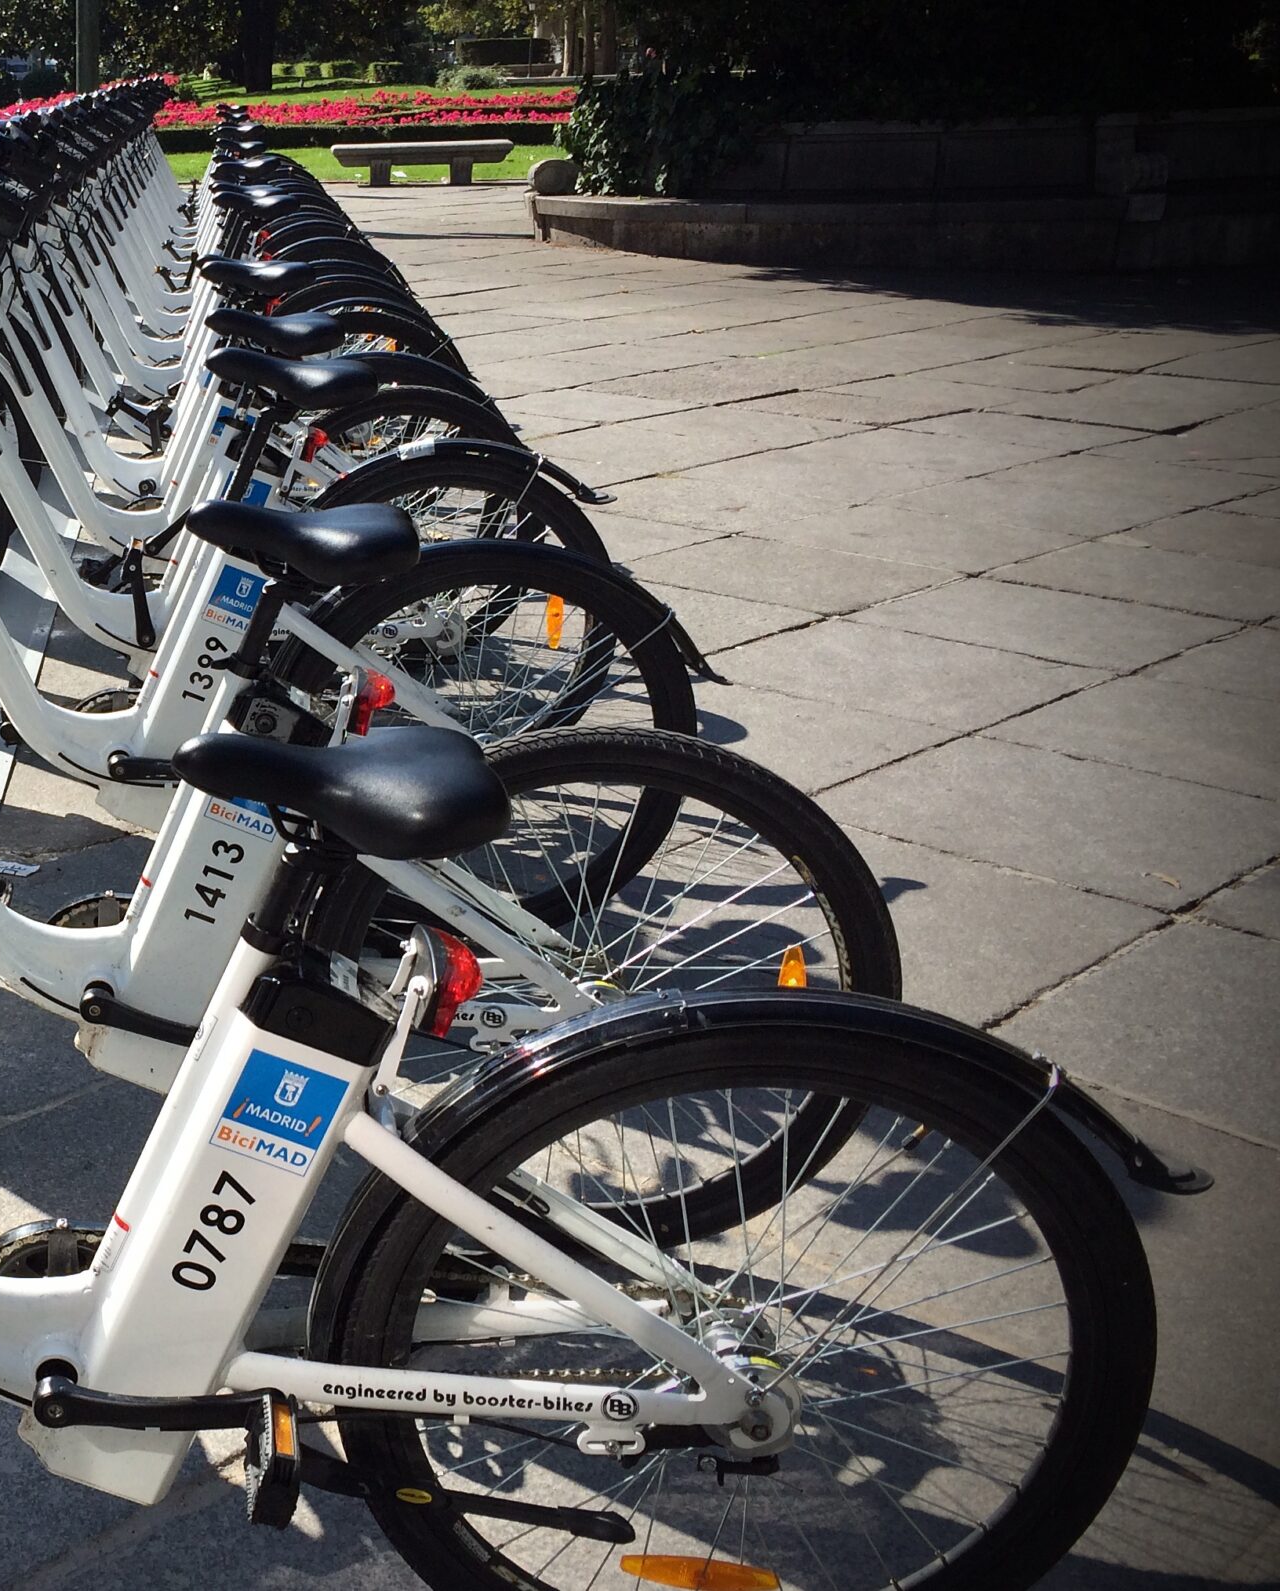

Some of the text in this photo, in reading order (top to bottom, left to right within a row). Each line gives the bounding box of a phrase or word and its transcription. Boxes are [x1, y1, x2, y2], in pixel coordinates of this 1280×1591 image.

[208, 802, 275, 836] BiciMAD
[183, 839, 246, 925] 1413
[816, 891, 853, 992] TRONG
[216, 1124, 308, 1168] BiciMAD
[171, 1169, 256, 1292] 0787
[322, 1383, 427, 1401] engineered
[433, 1388, 457, 1406] by
[463, 1391, 594, 1413] booster-bikes
